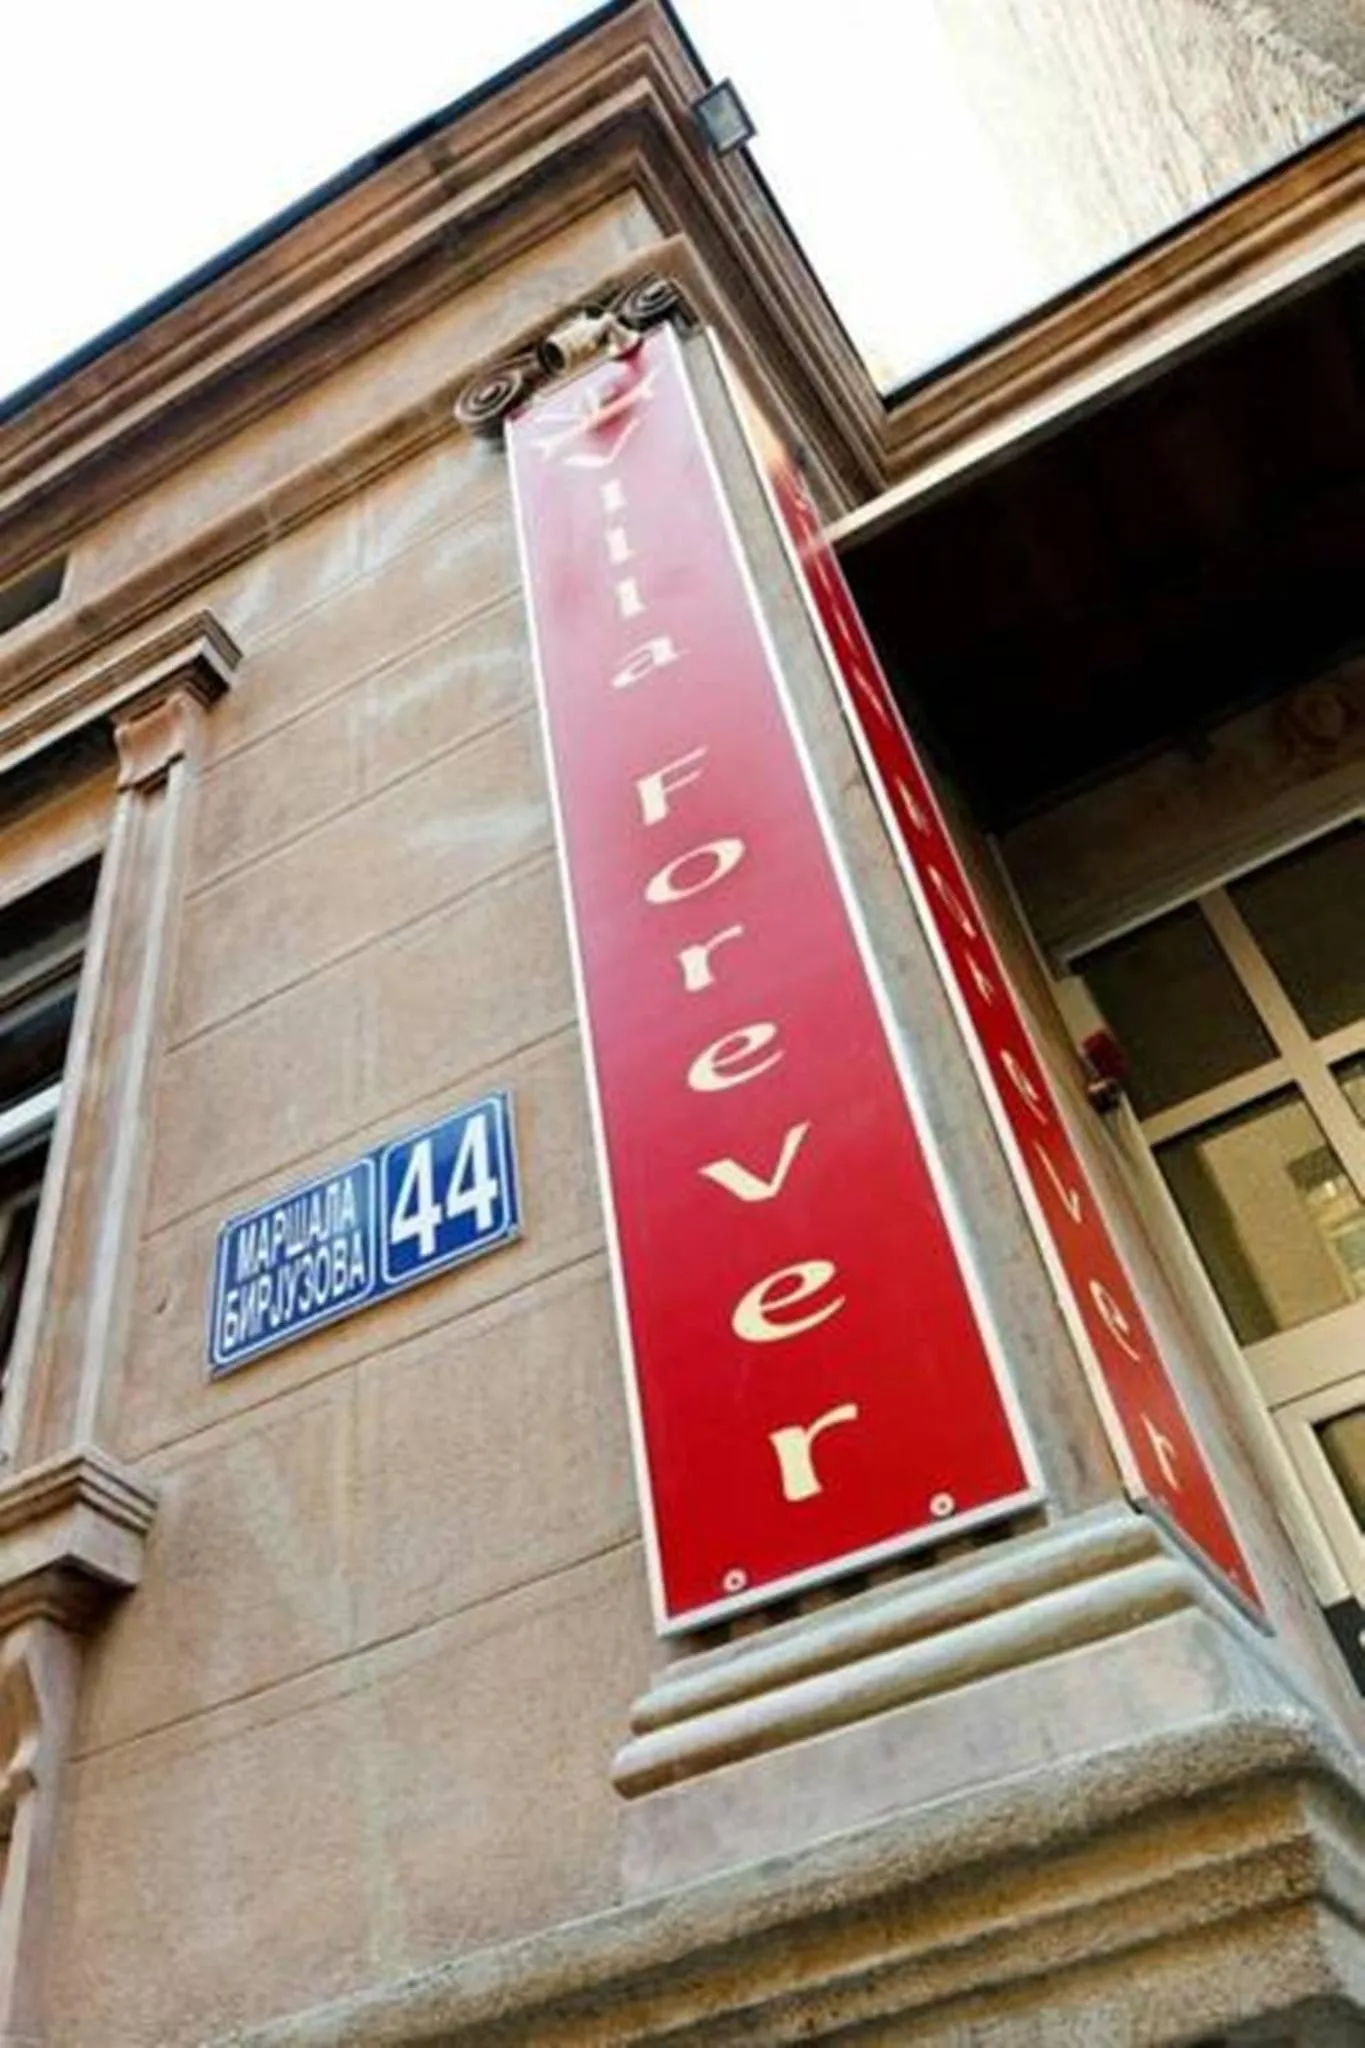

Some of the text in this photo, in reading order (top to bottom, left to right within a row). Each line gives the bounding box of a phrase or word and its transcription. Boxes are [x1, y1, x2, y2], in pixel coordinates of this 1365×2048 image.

[562, 416, 689, 689] Villa
[633, 747, 857, 1502] Forever
[237, 1176, 357, 1282] МАРШАЛА
[391, 1114, 497, 1257] 44
[223, 1232, 365, 1350] БИРЈУЗОВА
